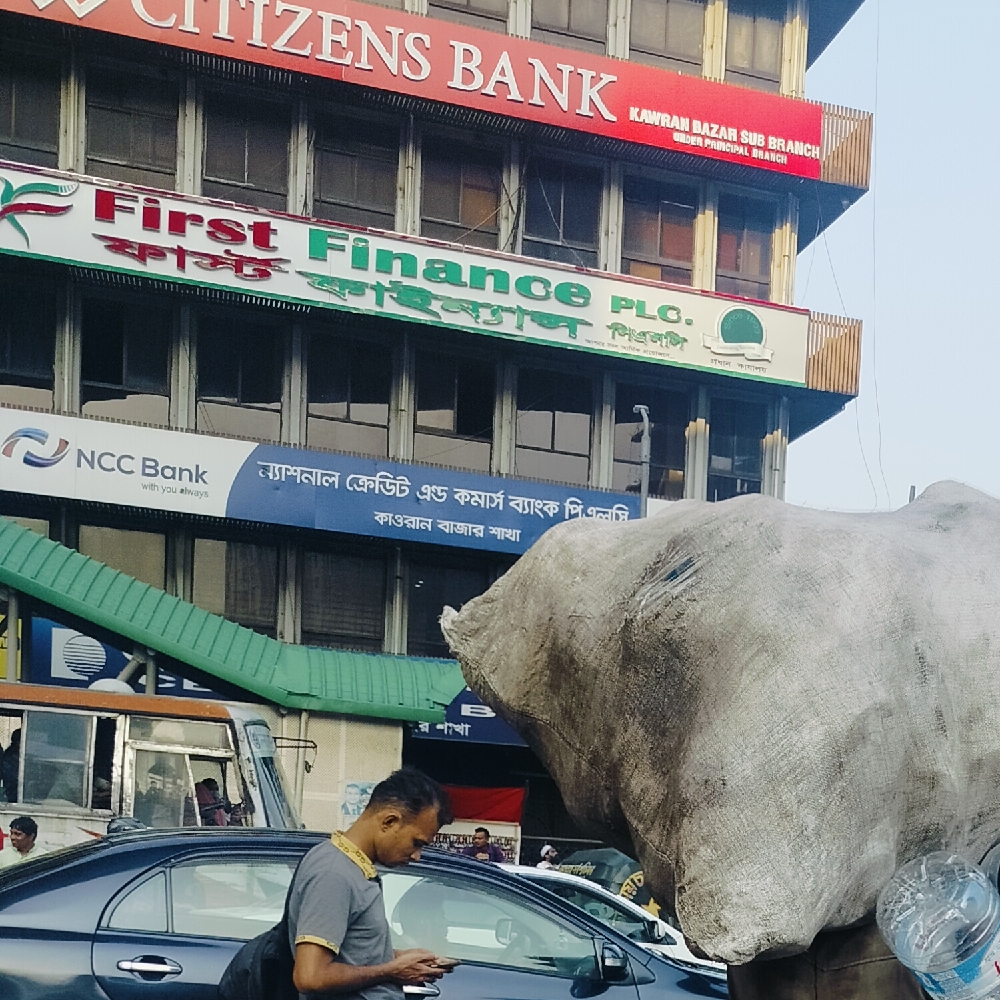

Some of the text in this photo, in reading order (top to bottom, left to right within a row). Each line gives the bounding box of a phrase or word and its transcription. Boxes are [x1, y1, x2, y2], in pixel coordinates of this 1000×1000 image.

[132, 0, 618, 122] CITIZENS BANK
[629, 106, 820, 159] KAWRAN BAZAR SUB BRANCH
[673, 132, 787, 165] UNDER PRINCIPAL BRANCH
[95, 188, 694, 325] First Finance PLC.
[77, 448, 208, 485] NCC Bank
[141, 482, 209, 499] with you always
[257, 461, 341, 489] ন্যাশনাল
[346, 471, 411, 498] ক্রেডিট
[453, 487, 505, 511] কমার্স
[508, 495, 560, 519] ব্যাংক
[373, 511, 521, 543] কাওরান বাজার শাখা
